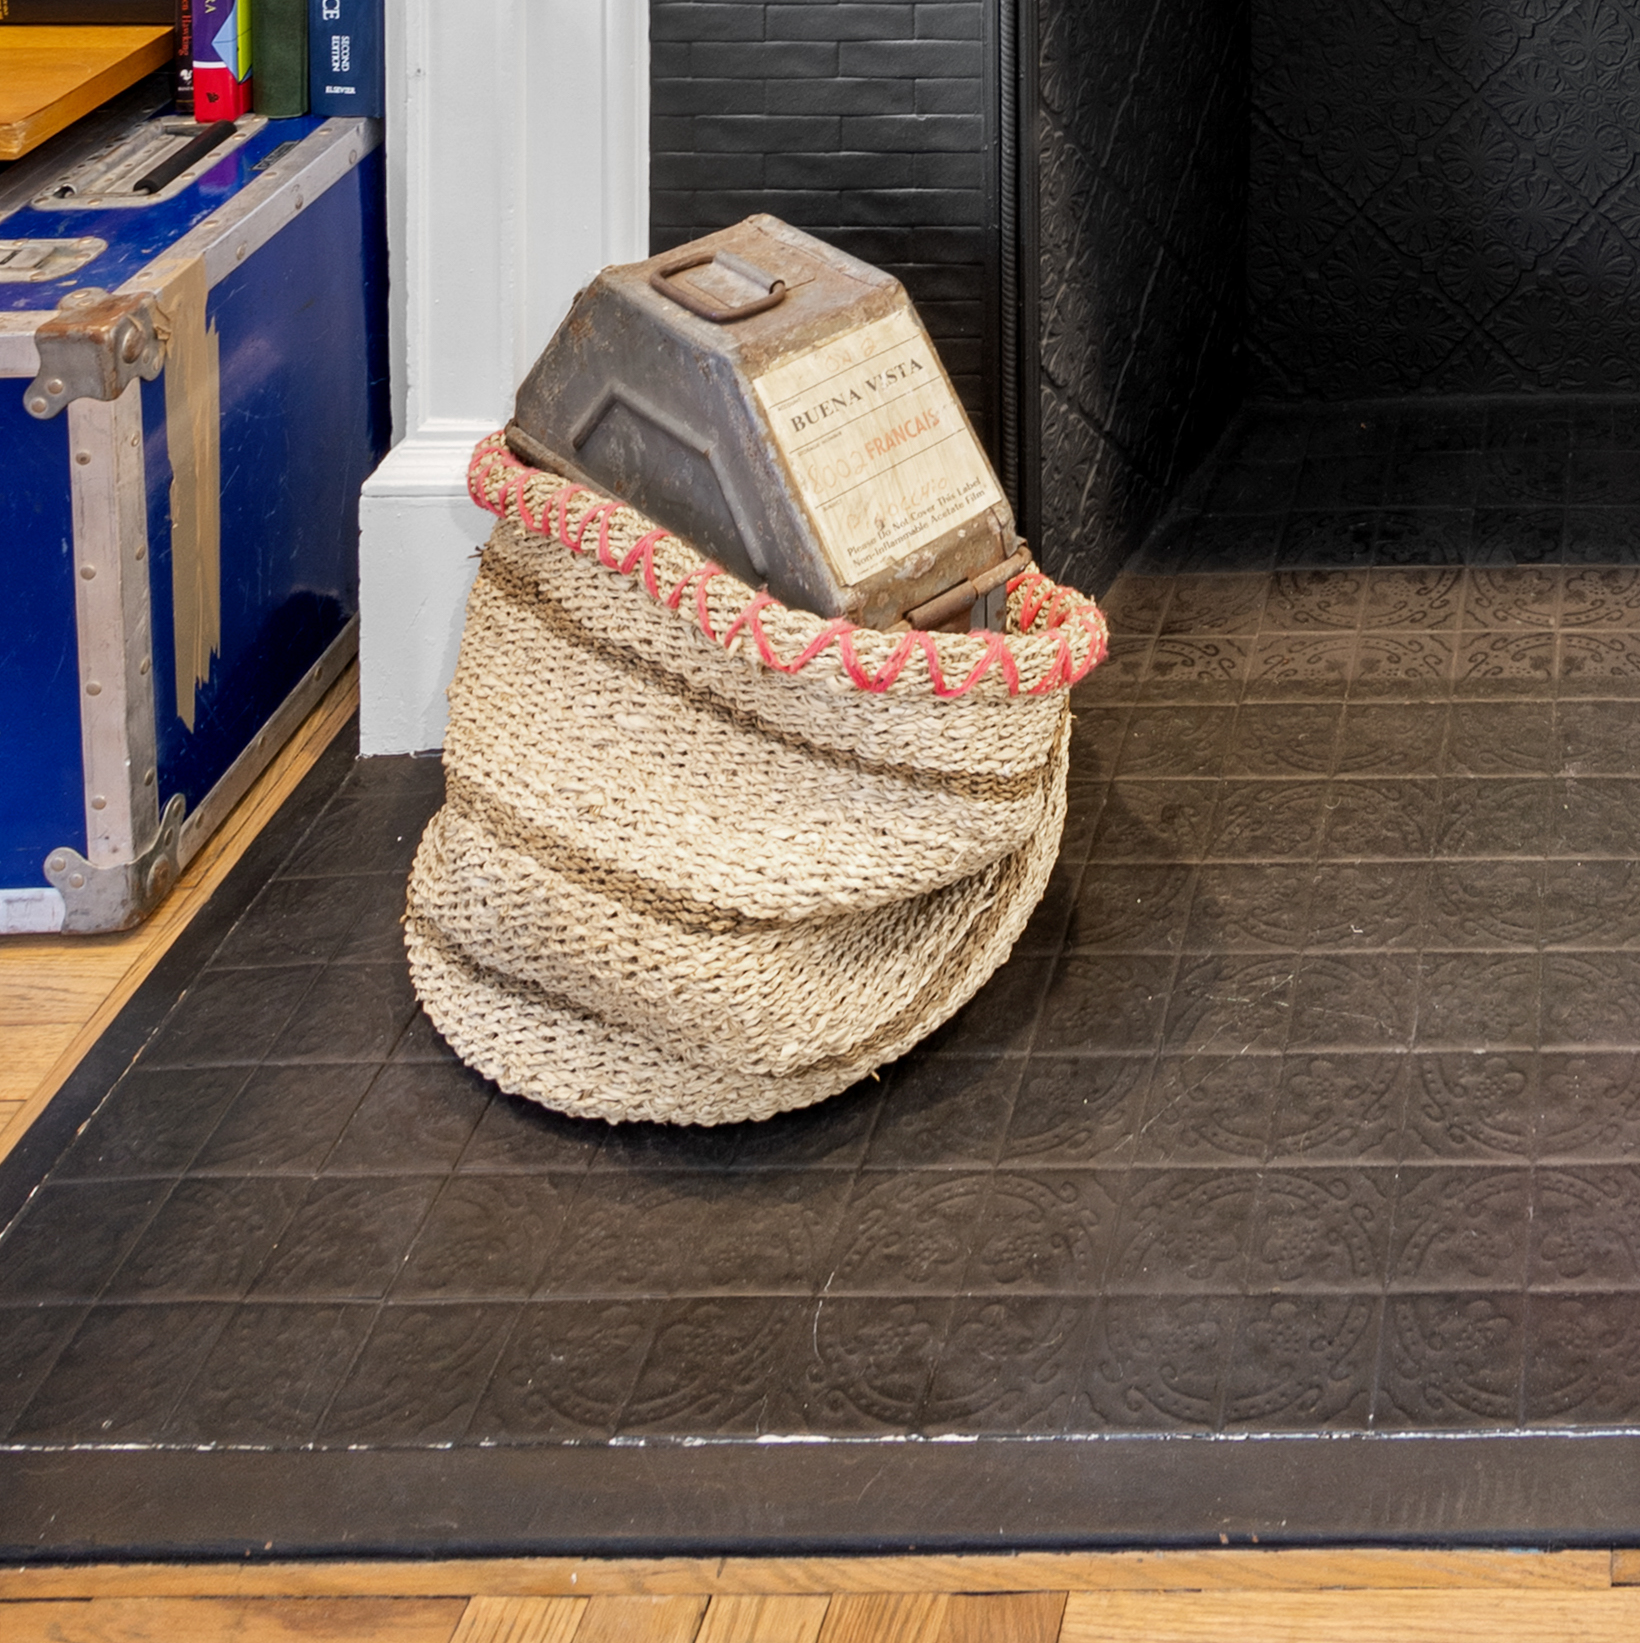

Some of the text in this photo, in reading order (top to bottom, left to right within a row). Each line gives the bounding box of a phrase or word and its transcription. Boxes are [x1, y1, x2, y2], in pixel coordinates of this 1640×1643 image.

[790, 358, 924, 433] BUENA VISTA
[864, 408, 940, 460] FRANCAIS
[853, 489, 986, 567] Non-Inflammable Acetate Film
